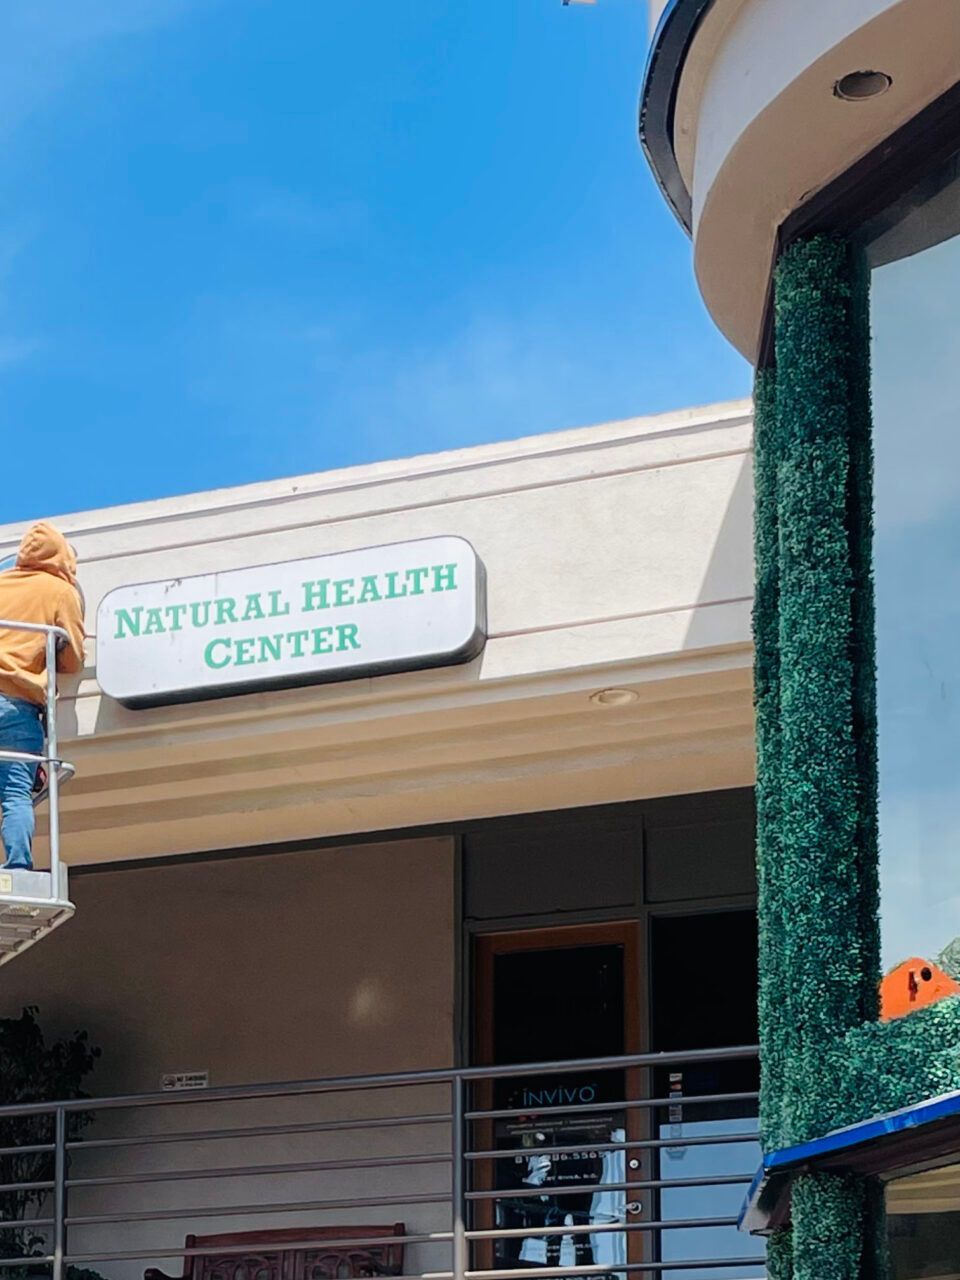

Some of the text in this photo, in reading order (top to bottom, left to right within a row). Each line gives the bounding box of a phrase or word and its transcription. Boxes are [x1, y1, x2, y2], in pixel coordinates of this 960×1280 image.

[113, 563, 458, 640] NATURAL HEALTH
[204, 623, 361, 670] CENTER
